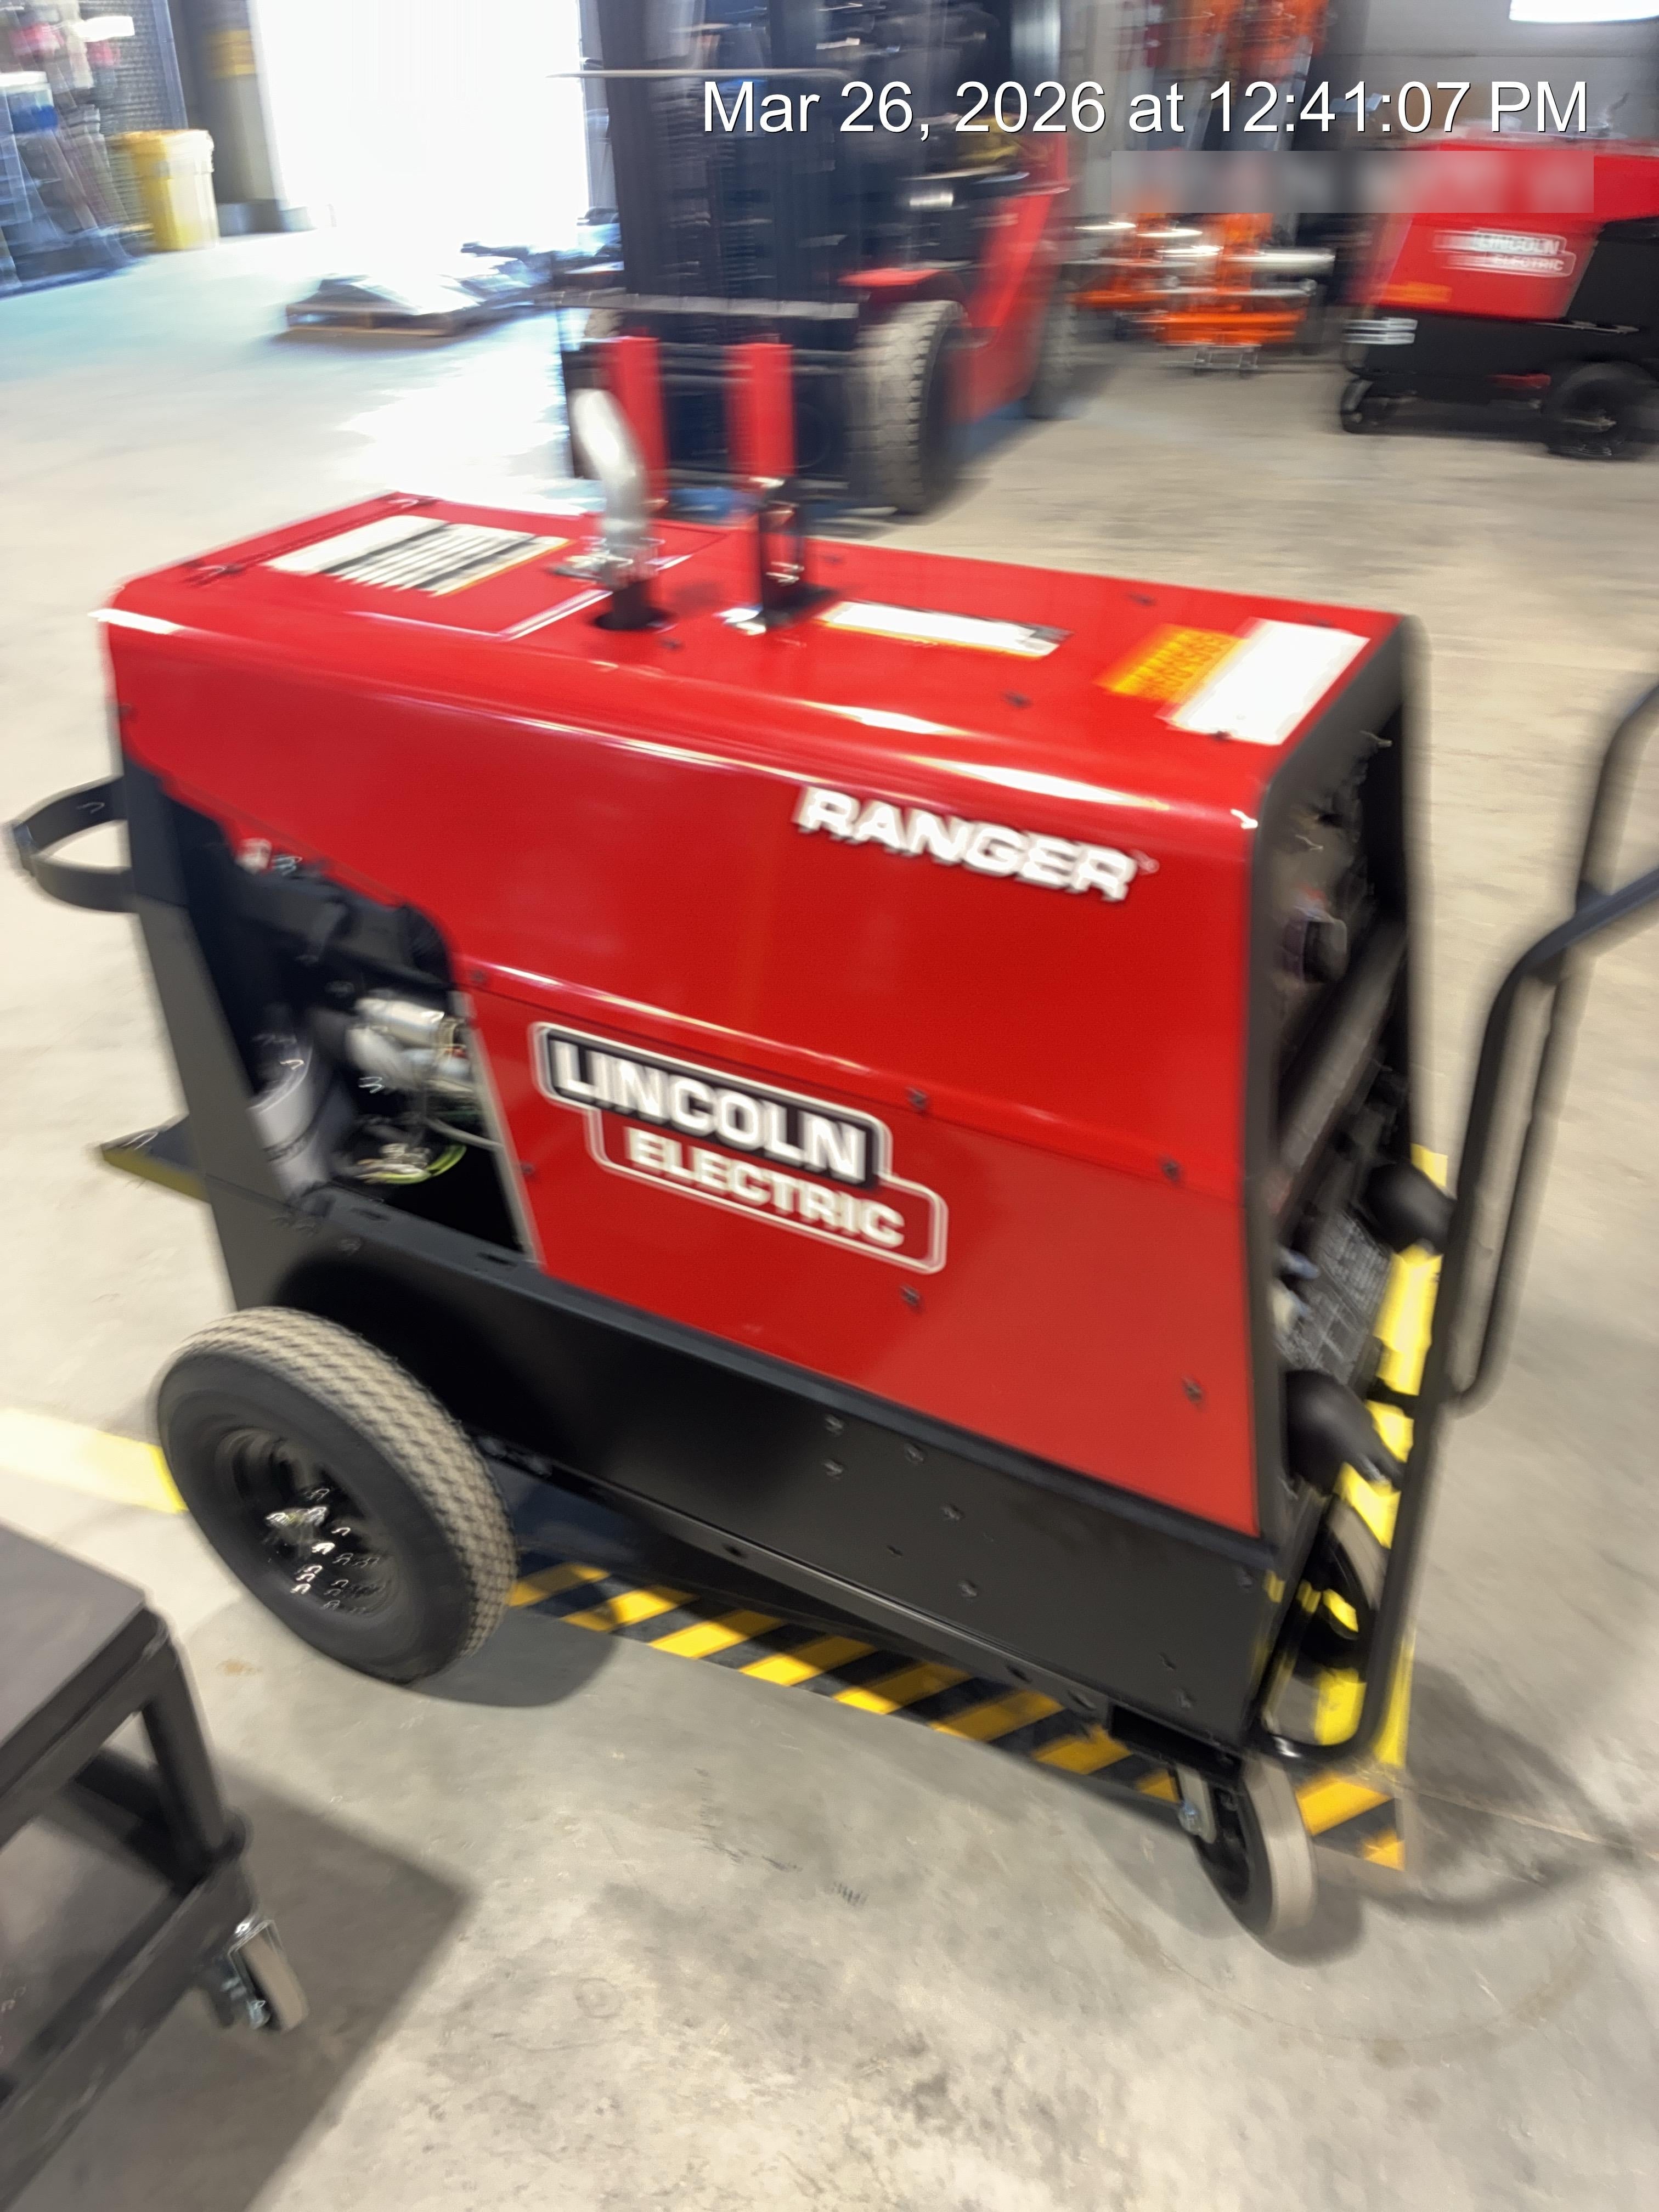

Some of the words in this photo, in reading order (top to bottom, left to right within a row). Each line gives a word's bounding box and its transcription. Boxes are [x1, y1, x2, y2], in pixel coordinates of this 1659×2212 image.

[793, 787, 1138, 901] RANGER
[549, 1040, 867, 1184] LINCOLN
[625, 1127, 905, 1248] ELECTRIC
